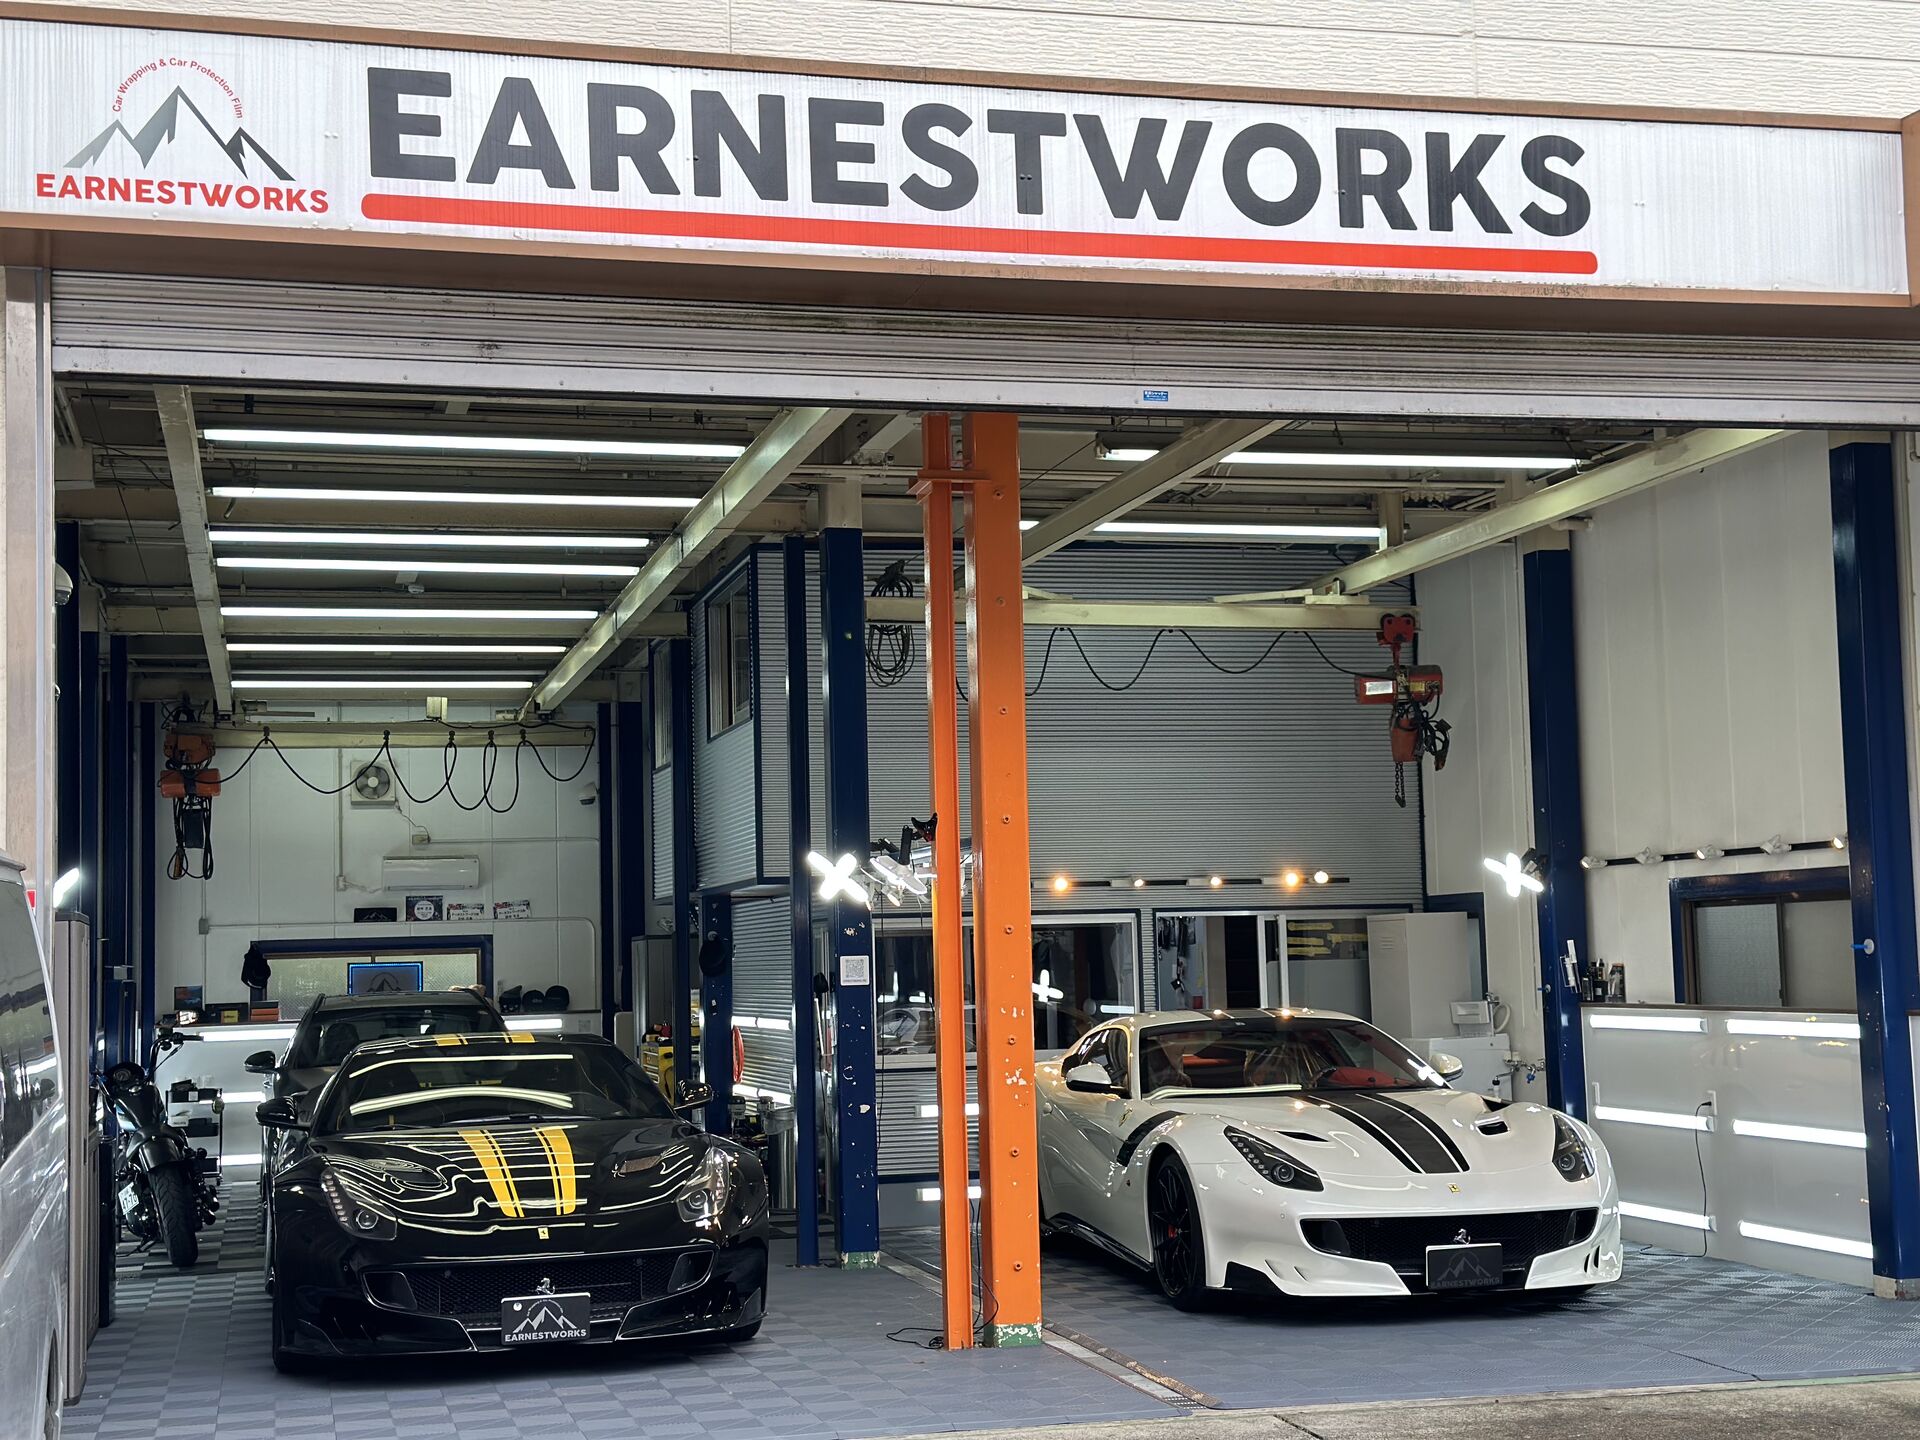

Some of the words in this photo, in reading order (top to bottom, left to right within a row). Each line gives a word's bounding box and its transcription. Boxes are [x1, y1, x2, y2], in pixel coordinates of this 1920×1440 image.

[159, 58, 167, 67] &
[169, 57, 188, 67] Car
[117, 62, 158, 94] Wrapping
[190, 60, 234, 97] Protection
[112, 95, 123, 113] Car
[231, 97, 243, 119] Film
[367, 66, 1591, 237] EARNESTWORKS
[36, 173, 329, 213] EARNESTWORKS
[505, 1329, 587, 1342] EARNESTWORKS
